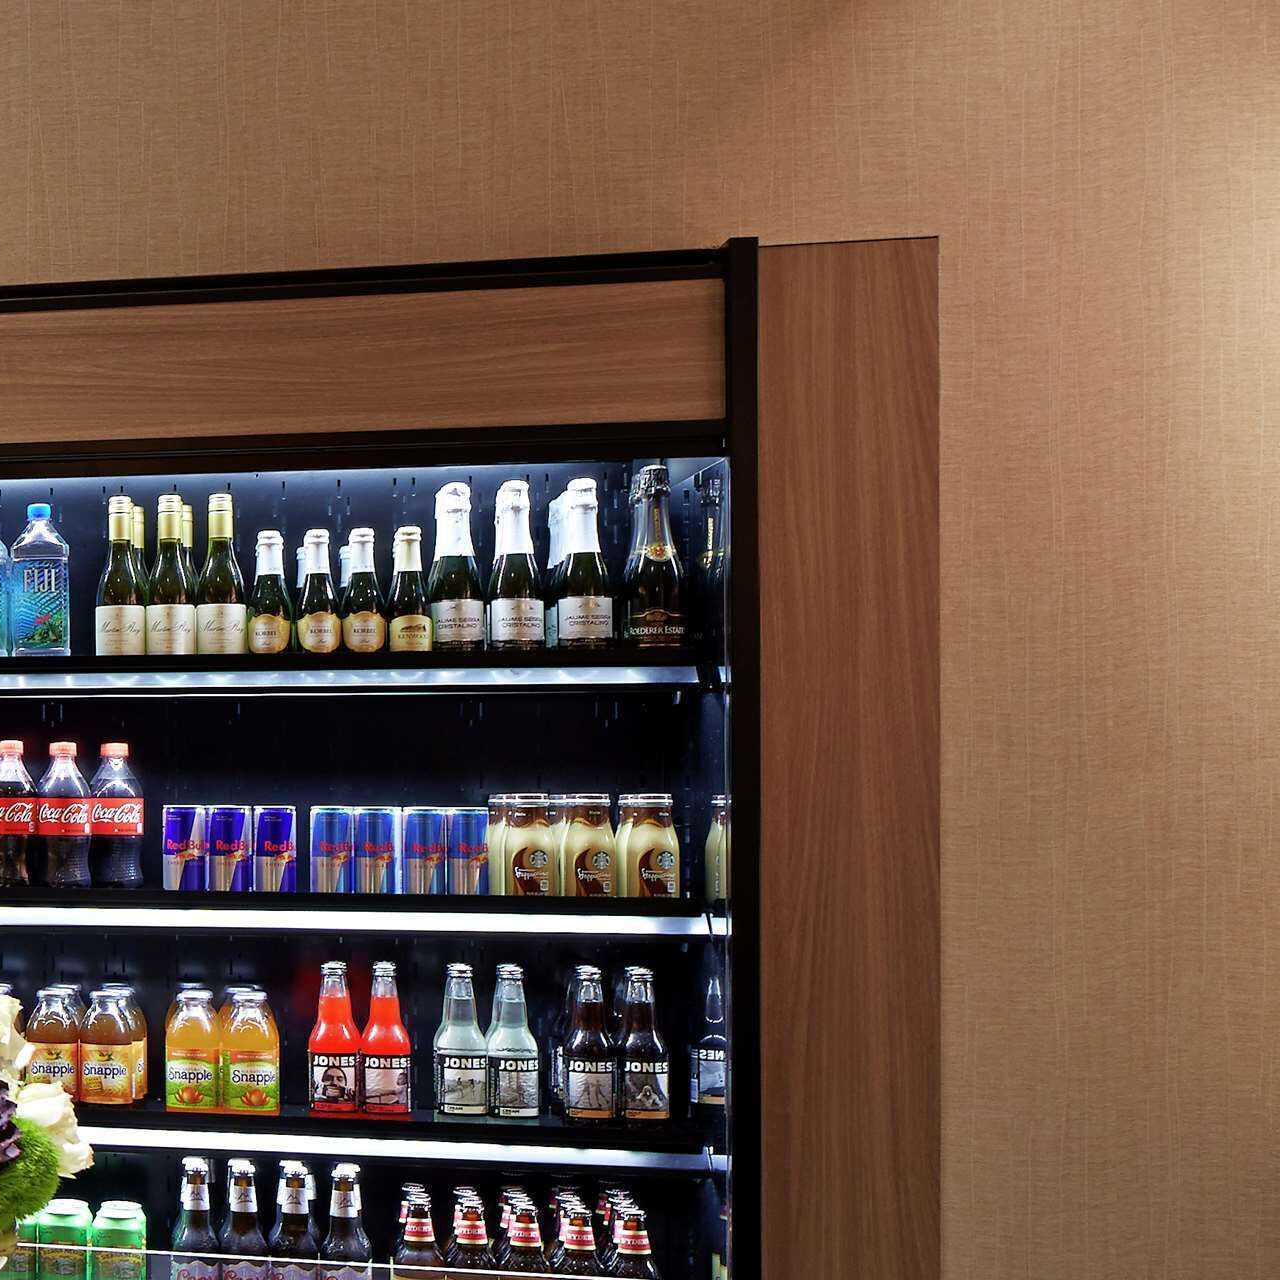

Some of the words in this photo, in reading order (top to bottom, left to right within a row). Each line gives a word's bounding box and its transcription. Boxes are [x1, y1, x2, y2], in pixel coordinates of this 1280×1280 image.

[24, 568, 57, 593] FIJI
[629, 627, 663, 636] ROEDERER
[39, 802, 89, 823] Coca-Cola
[91, 802, 141, 823] Coca-Cola
[167, 840, 187, 850] Red
[215, 840, 238, 851] Red
[264, 841, 287, 852] Red
[312, 1055, 355, 1067] JONES
[364, 1056, 407, 1068] JONES
[443, 1057, 486, 1069] JONES
[499, 1060, 539, 1071] JONES
[568, 1061, 613, 1073] JONES
[624, 1061, 668, 1073] JONES
[31, 1061, 75, 1079] Snapple
[83, 1062, 127, 1080] Snapple
[168, 1066, 213, 1085] Snapple
[231, 1068, 276, 1086] Snapple
